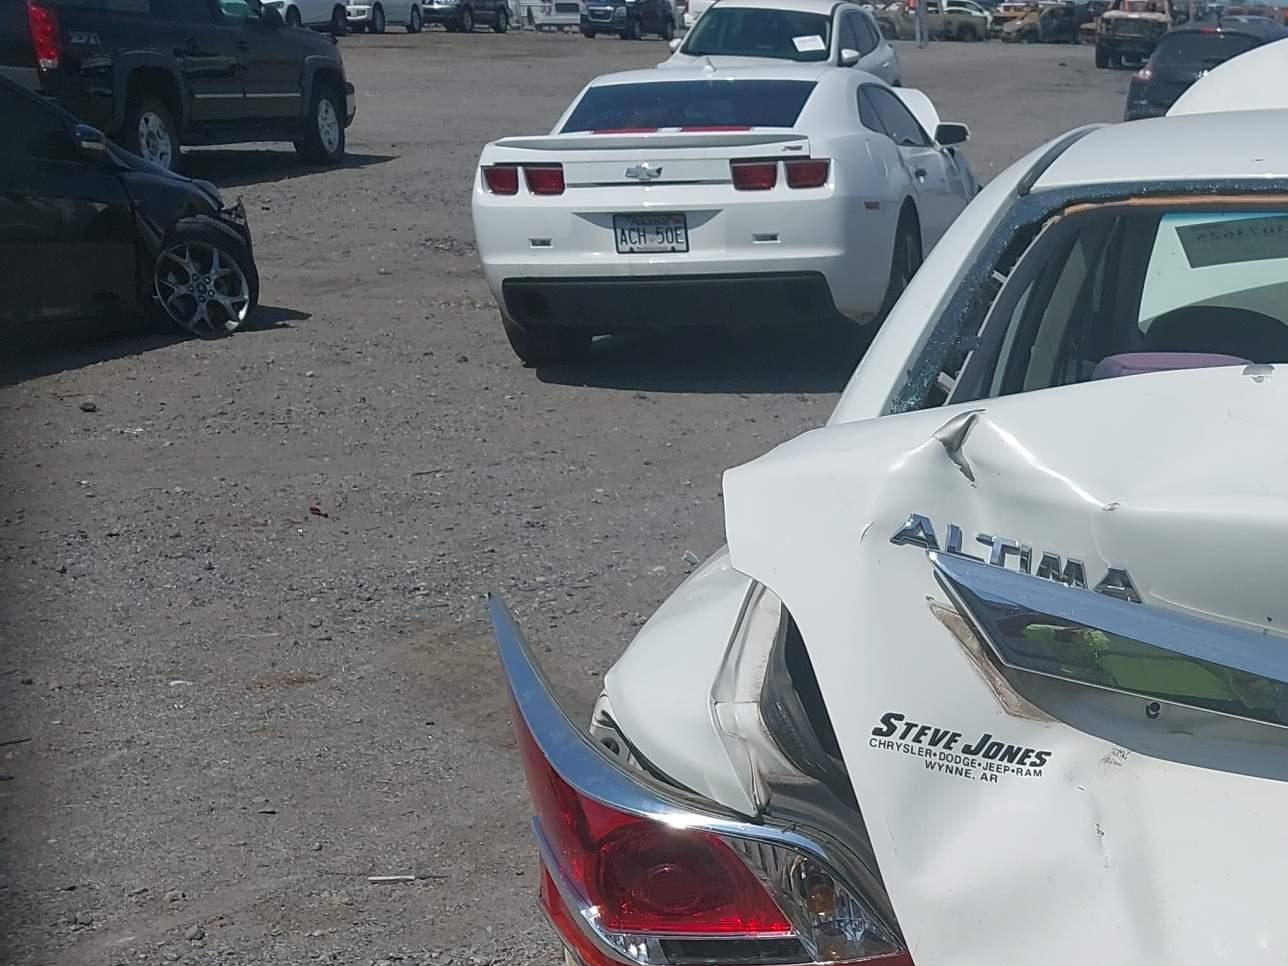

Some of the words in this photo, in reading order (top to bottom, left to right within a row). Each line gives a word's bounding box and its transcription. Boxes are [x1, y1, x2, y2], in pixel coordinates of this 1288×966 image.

[619, 228, 647, 246] ACH
[889, 513, 1144, 604] ALTIMA
[871, 712, 962, 751] STEVE
[961, 733, 1052, 767] JONES
[979, 772, 998, 783] AR
